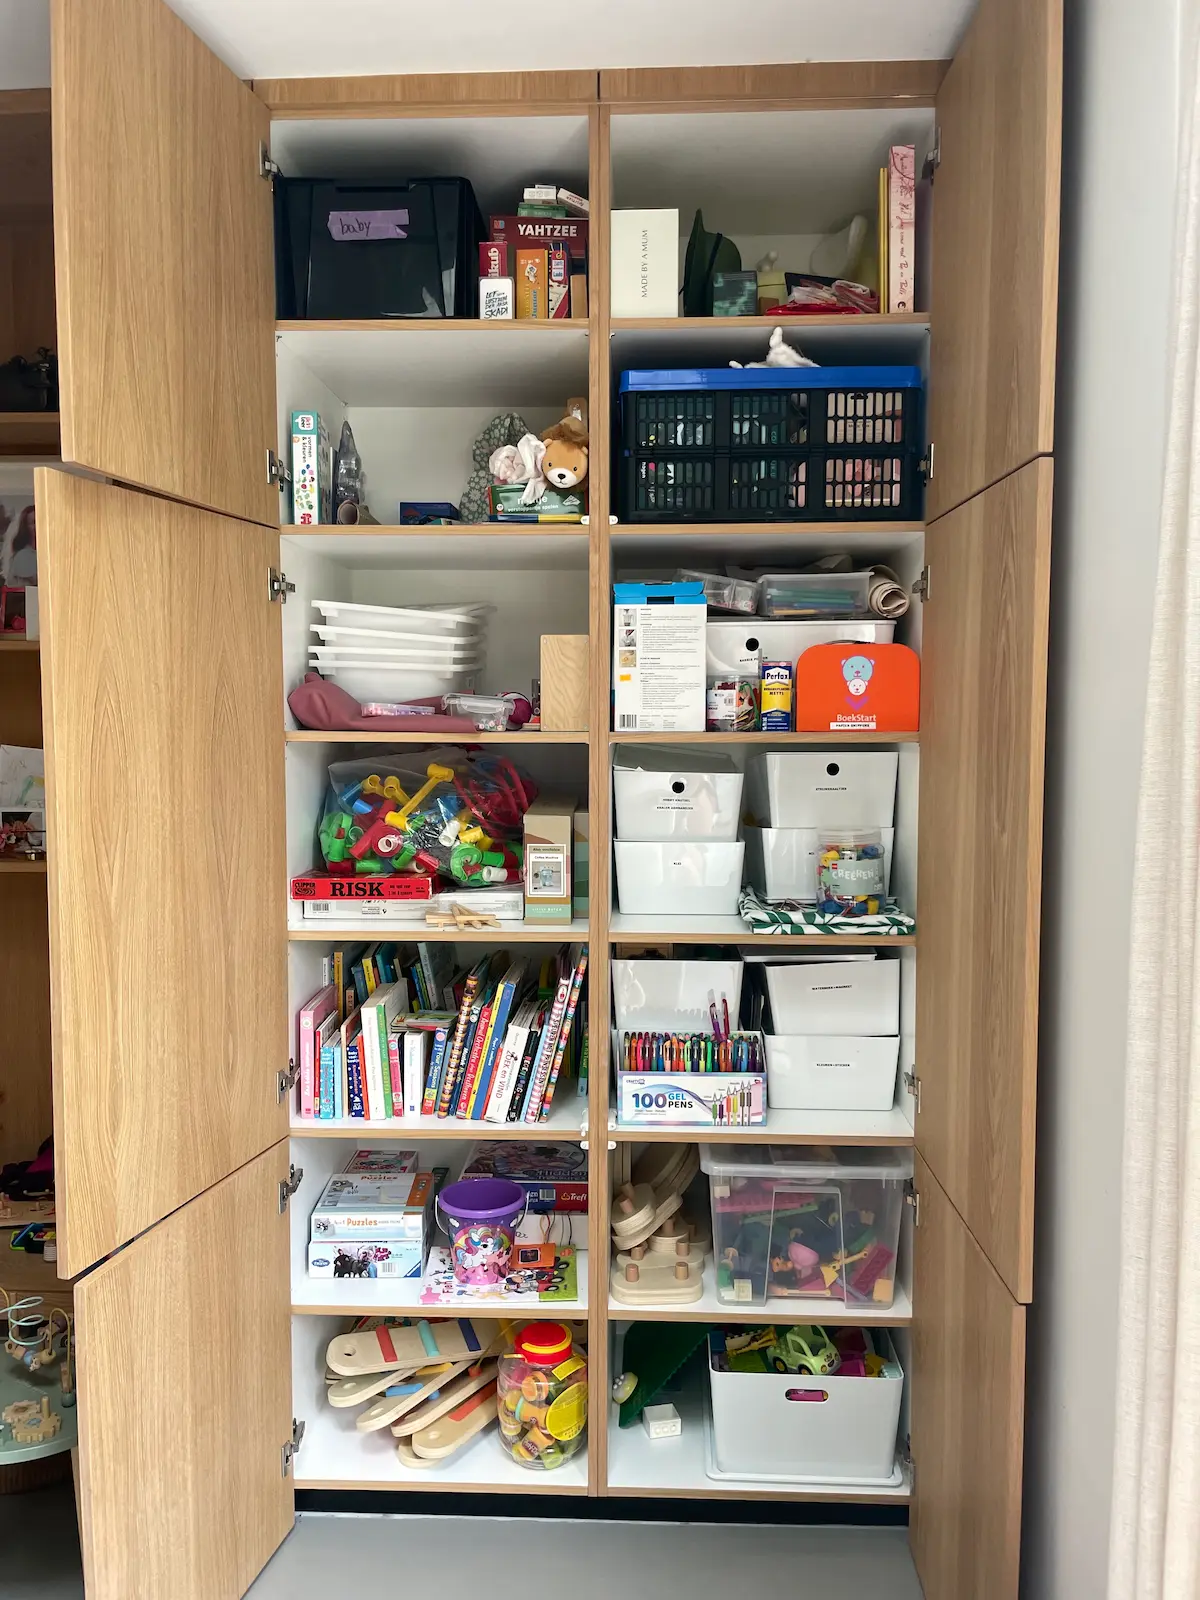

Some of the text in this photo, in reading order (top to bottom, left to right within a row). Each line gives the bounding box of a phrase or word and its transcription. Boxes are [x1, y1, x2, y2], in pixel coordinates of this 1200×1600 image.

[340, 218, 371, 237] baby
[518, 224, 578, 237] YAHTZEE
[488, 248, 499, 277] ikub
[641, 261, 648, 272] BY
[484, 307, 508, 319] SKADI
[766, 672, 788, 680] Perfax
[836, 714, 876, 722] BoekStart
[330, 882, 385, 897] RISK
[476, 1017, 488, 1036] Animal
[471, 1036, 483, 1063] Orchestra
[502, 1050, 514, 1068] ZOEK
[431, 1066, 440, 1088] Seasons
[500, 1070, 506, 1078] en
[462, 1073, 474, 1100] Beethoven
[495, 1081, 505, 1099] VIND
[632, 1093, 667, 1108] 100
[668, 1100, 694, 1109] PENS
[570, 1192, 588, 1202] Trefl
[346, 1218, 378, 1226] Puzzles
